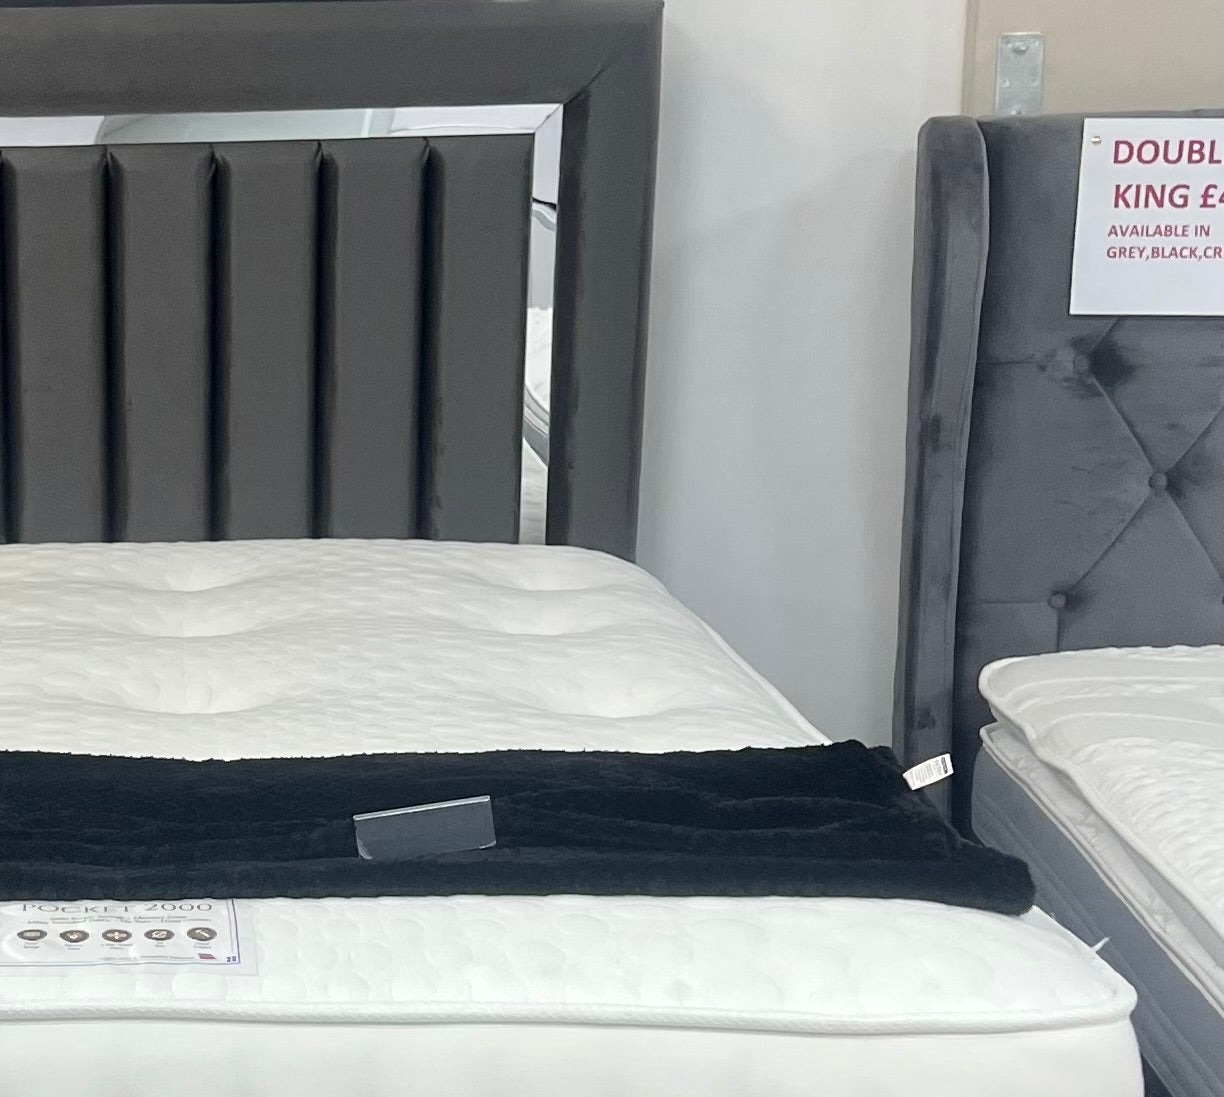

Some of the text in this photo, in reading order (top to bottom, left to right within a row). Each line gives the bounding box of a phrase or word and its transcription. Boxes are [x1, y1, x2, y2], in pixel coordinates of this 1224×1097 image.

[1113, 139, 1223, 165] DOUBL
[1113, 184, 1190, 209] KING
[1108, 225, 1211, 238] AVAILABLE IN
[22, 903, 213, 914] POCKET 2000
